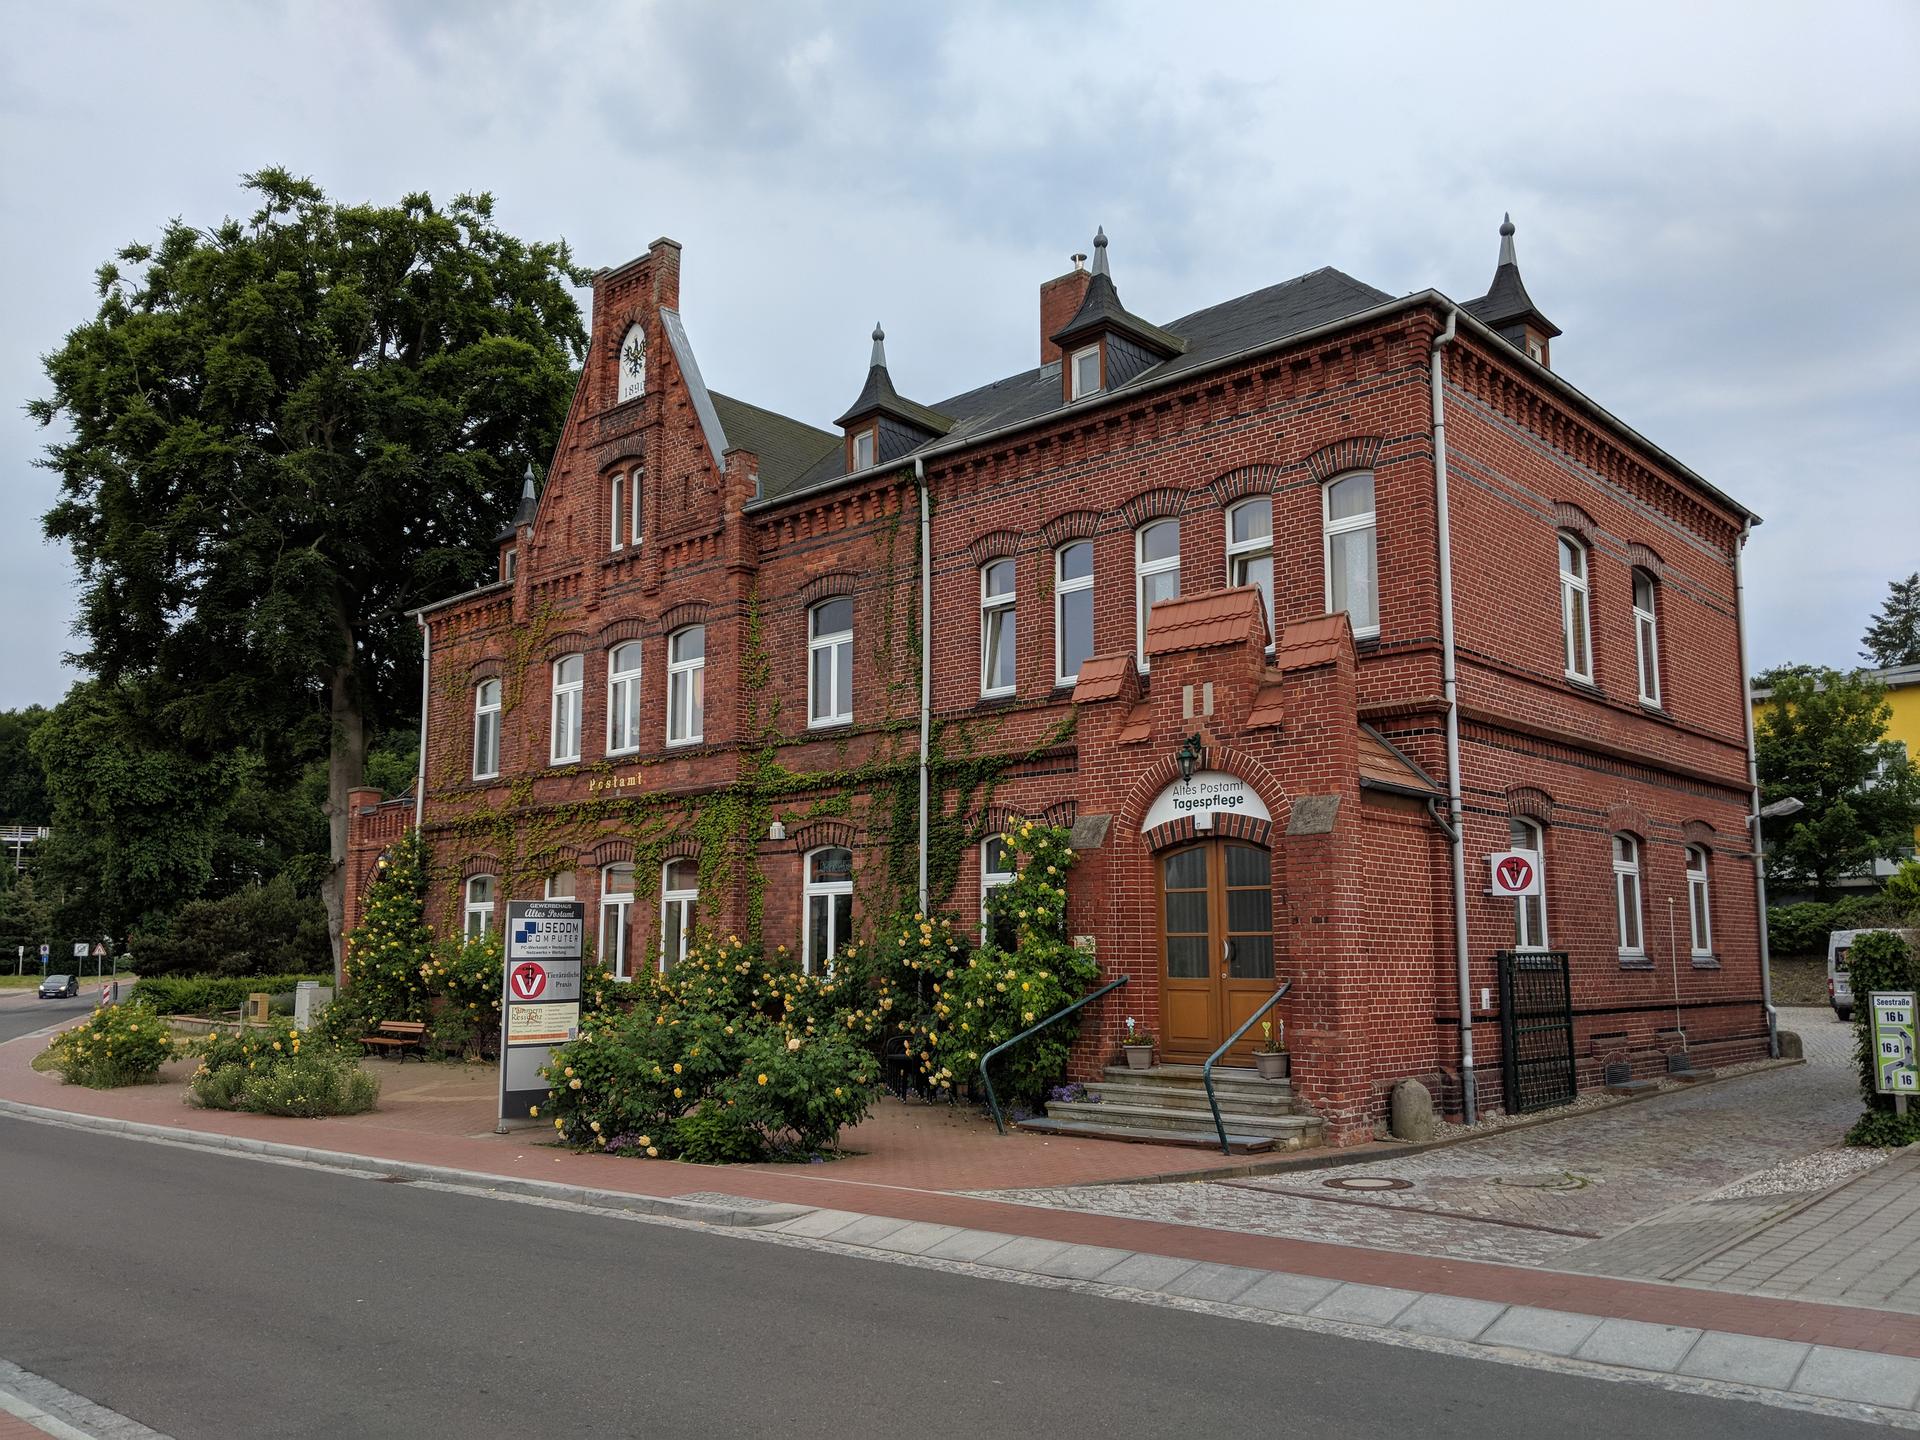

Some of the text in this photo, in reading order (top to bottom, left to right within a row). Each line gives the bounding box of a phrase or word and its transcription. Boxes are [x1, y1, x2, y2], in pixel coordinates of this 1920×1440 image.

[589, 772, 642, 791] Postamt
[1172, 780, 1244, 797] Altes Postamt
[1172, 795, 1244, 811] Tagespflege
[524, 909, 575, 918] Altes Postamt
[537, 922, 579, 933] USEDOM
[528, 935, 579, 943] COMPUTER
[1876, 998, 1910, 1006] Seestraße
[1885, 1011, 1904, 1022] 16 b
[1881, 1043, 1900, 1053] 16 a
[1901, 1075, 1912, 1085] 16
